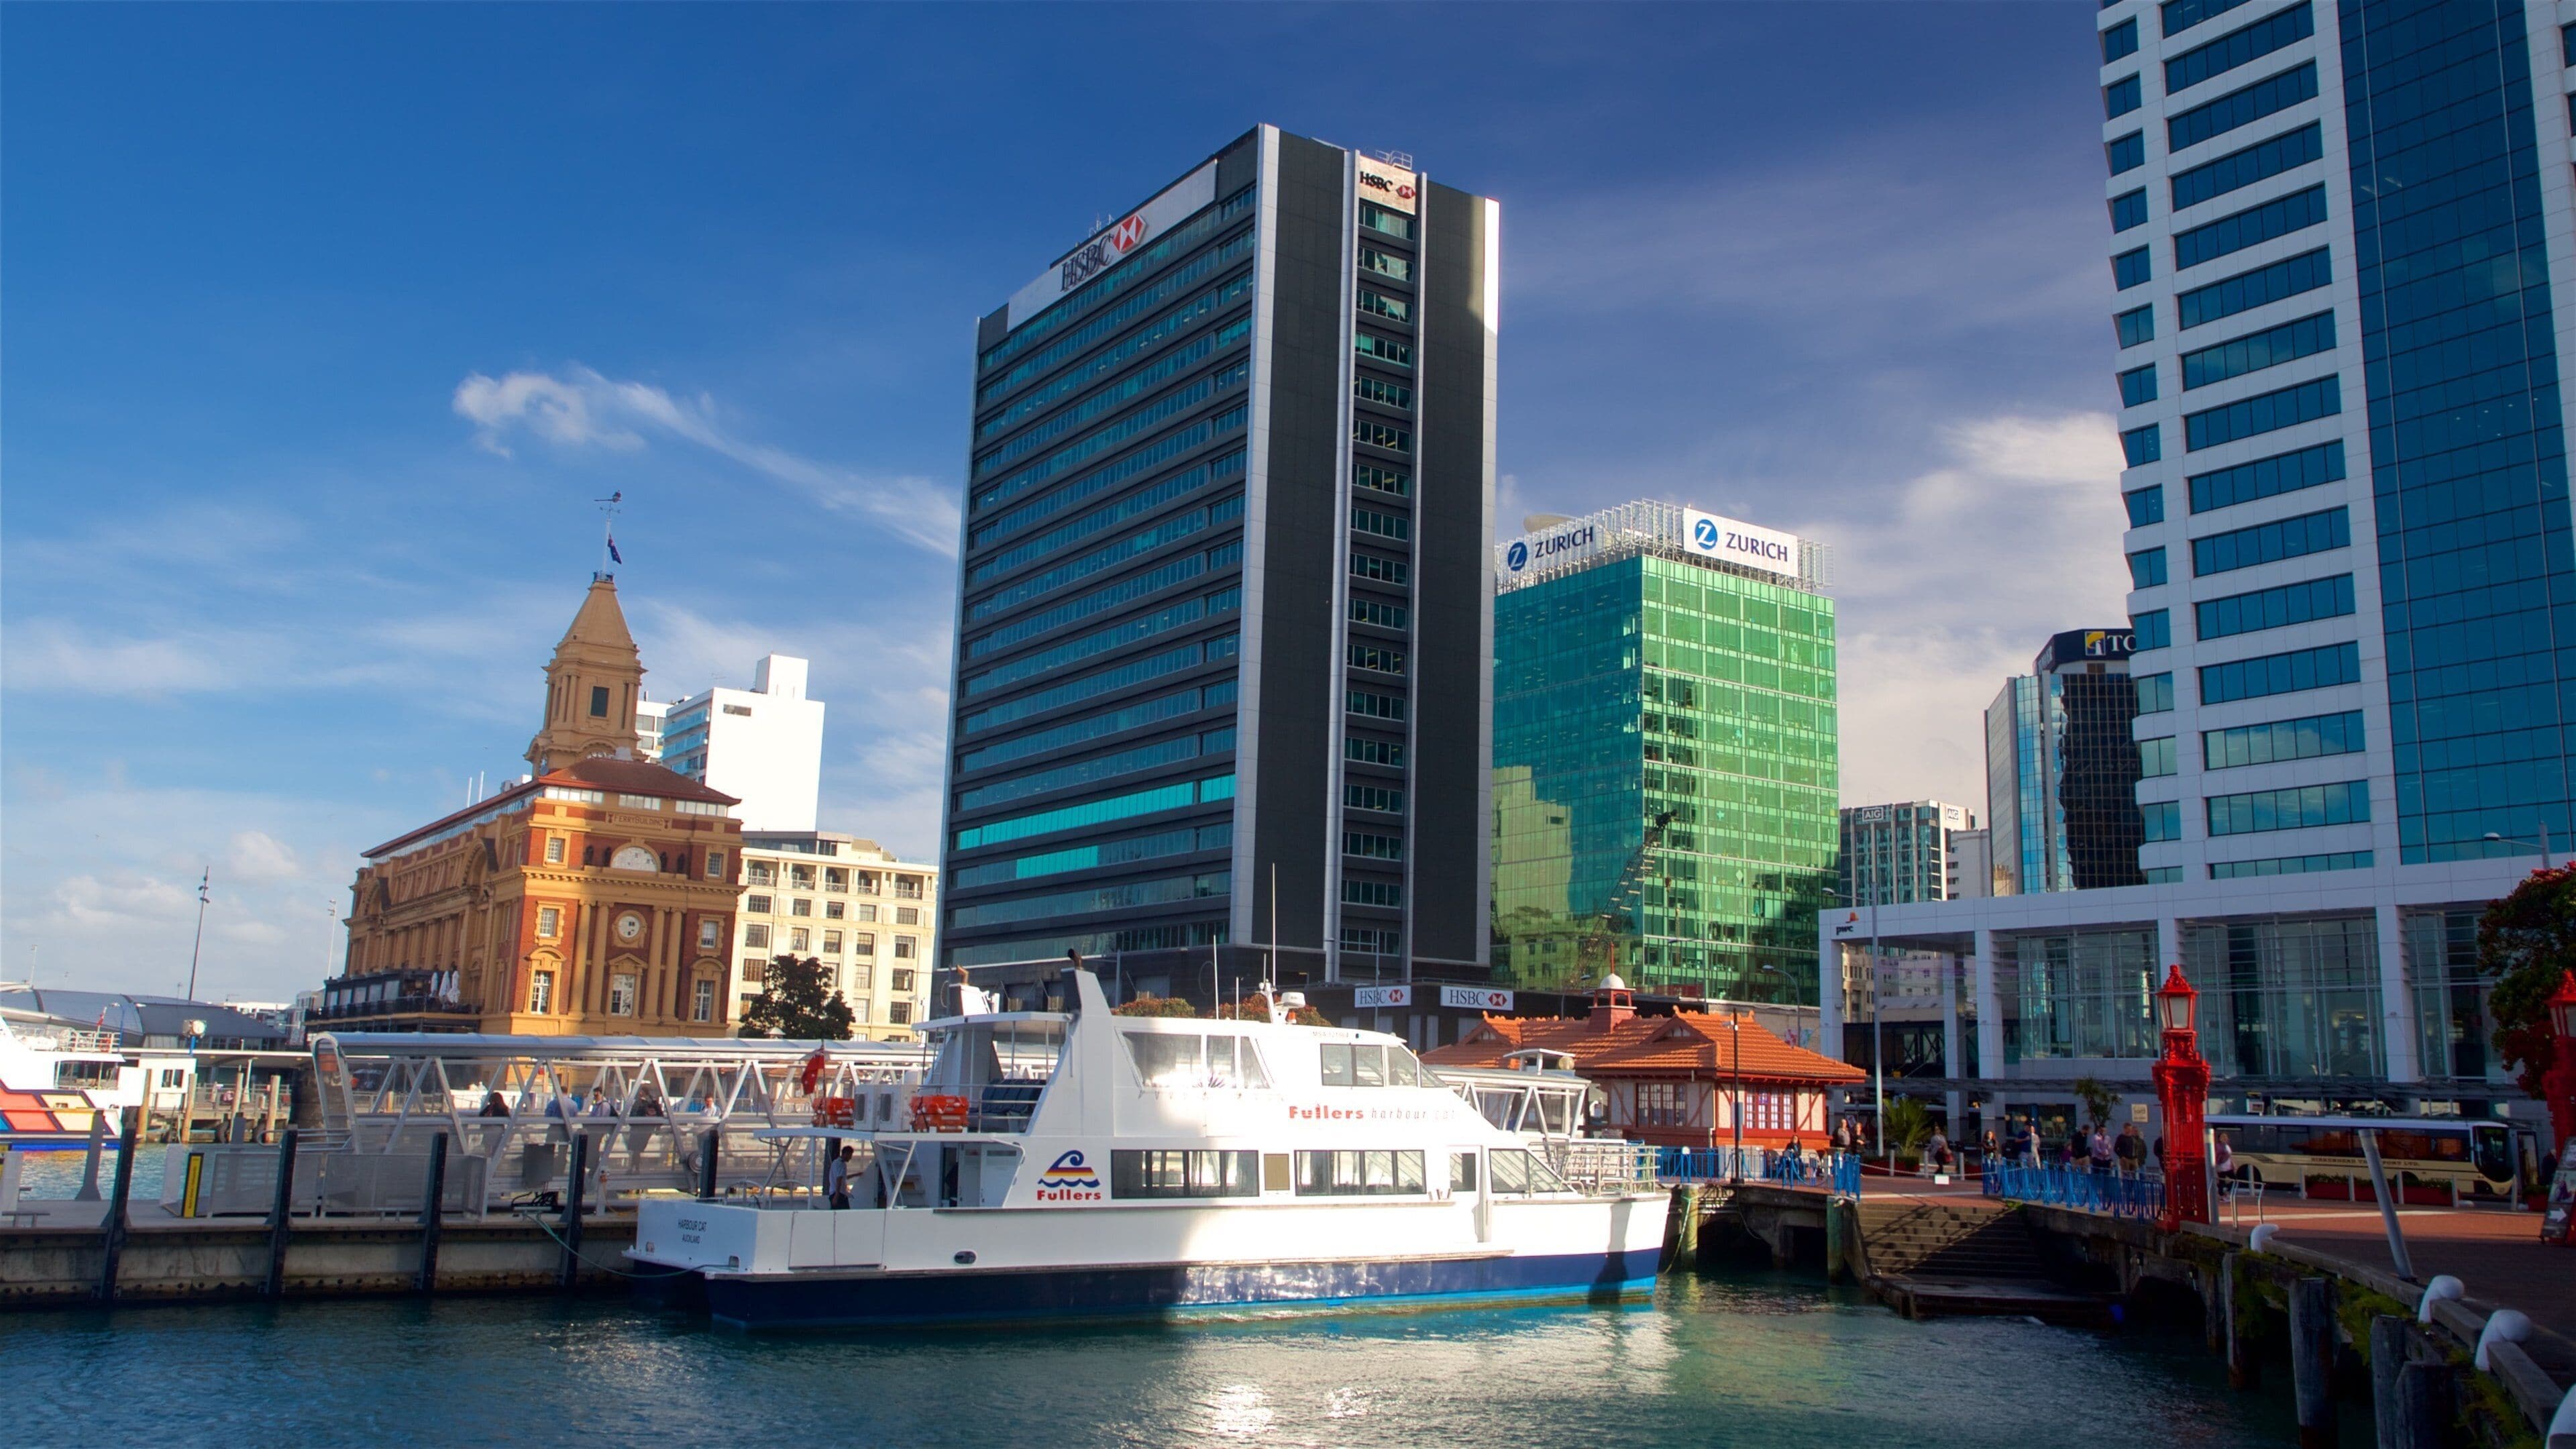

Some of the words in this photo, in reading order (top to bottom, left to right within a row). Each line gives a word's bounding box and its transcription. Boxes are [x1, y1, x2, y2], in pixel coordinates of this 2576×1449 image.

[1360, 171, 1393, 193] HSBC
[1061, 233, 1114, 292] HSBC
[1535, 526, 1593, 558] ZURICH
[1726, 532, 1788, 562] ZURICH
[1864, 808, 1881, 819] AIG
[1947, 808, 1959, 819] AIG
[1836, 926, 1854, 935] pwc
[1360, 989, 1387, 1004] HSBC
[1450, 989, 1485, 1006] HSBC
[1289, 1105, 1364, 1119] Fullers
[1371, 1107, 1427, 1120] harbour
[1037, 1189, 1102, 1201] Fullers
[678, 1219, 698, 1230] HARBOUR
[698, 1221, 707, 1232] CAT
